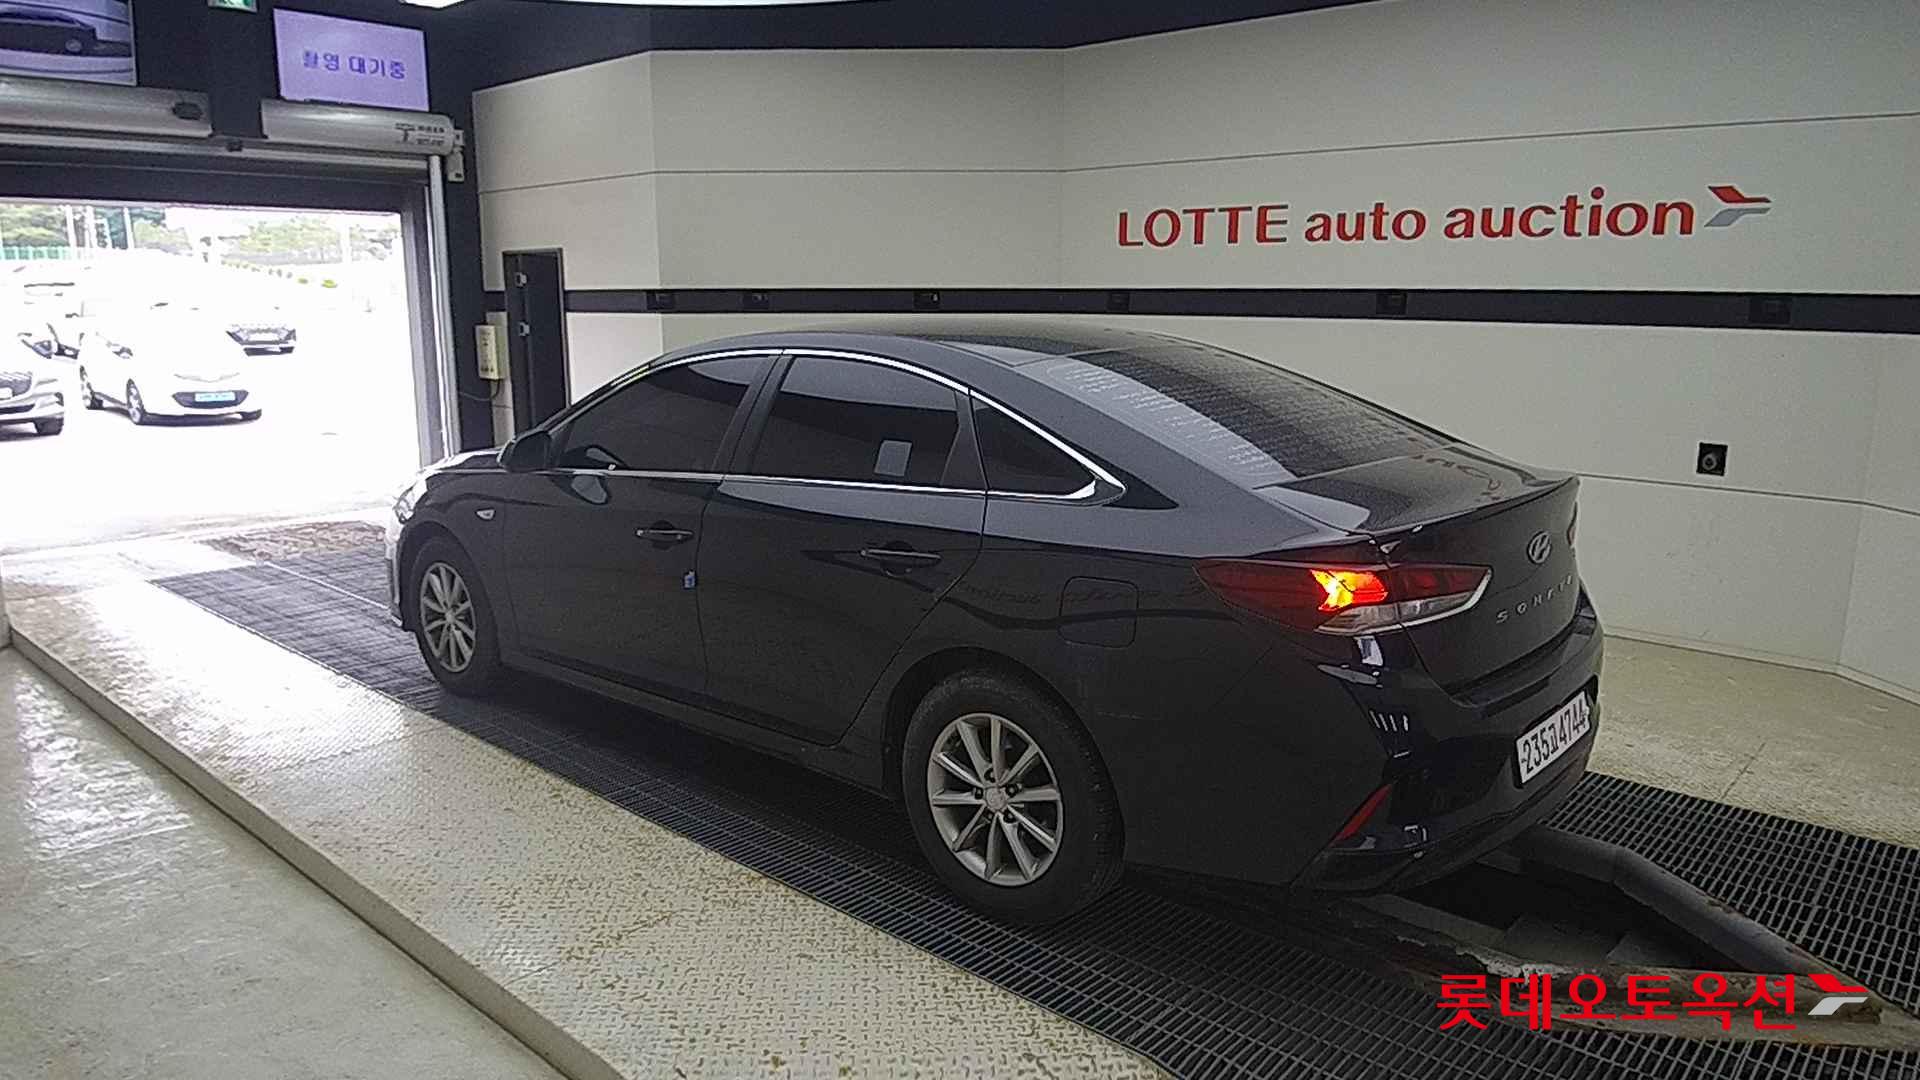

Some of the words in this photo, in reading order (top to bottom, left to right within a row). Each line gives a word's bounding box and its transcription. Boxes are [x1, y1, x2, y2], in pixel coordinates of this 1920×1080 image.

[349, 55, 405, 79] 대기중
[1118, 204, 1289, 247] LOTTE
[1304, 200, 1426, 242] auto
[1443, 187, 1694, 239] auction
